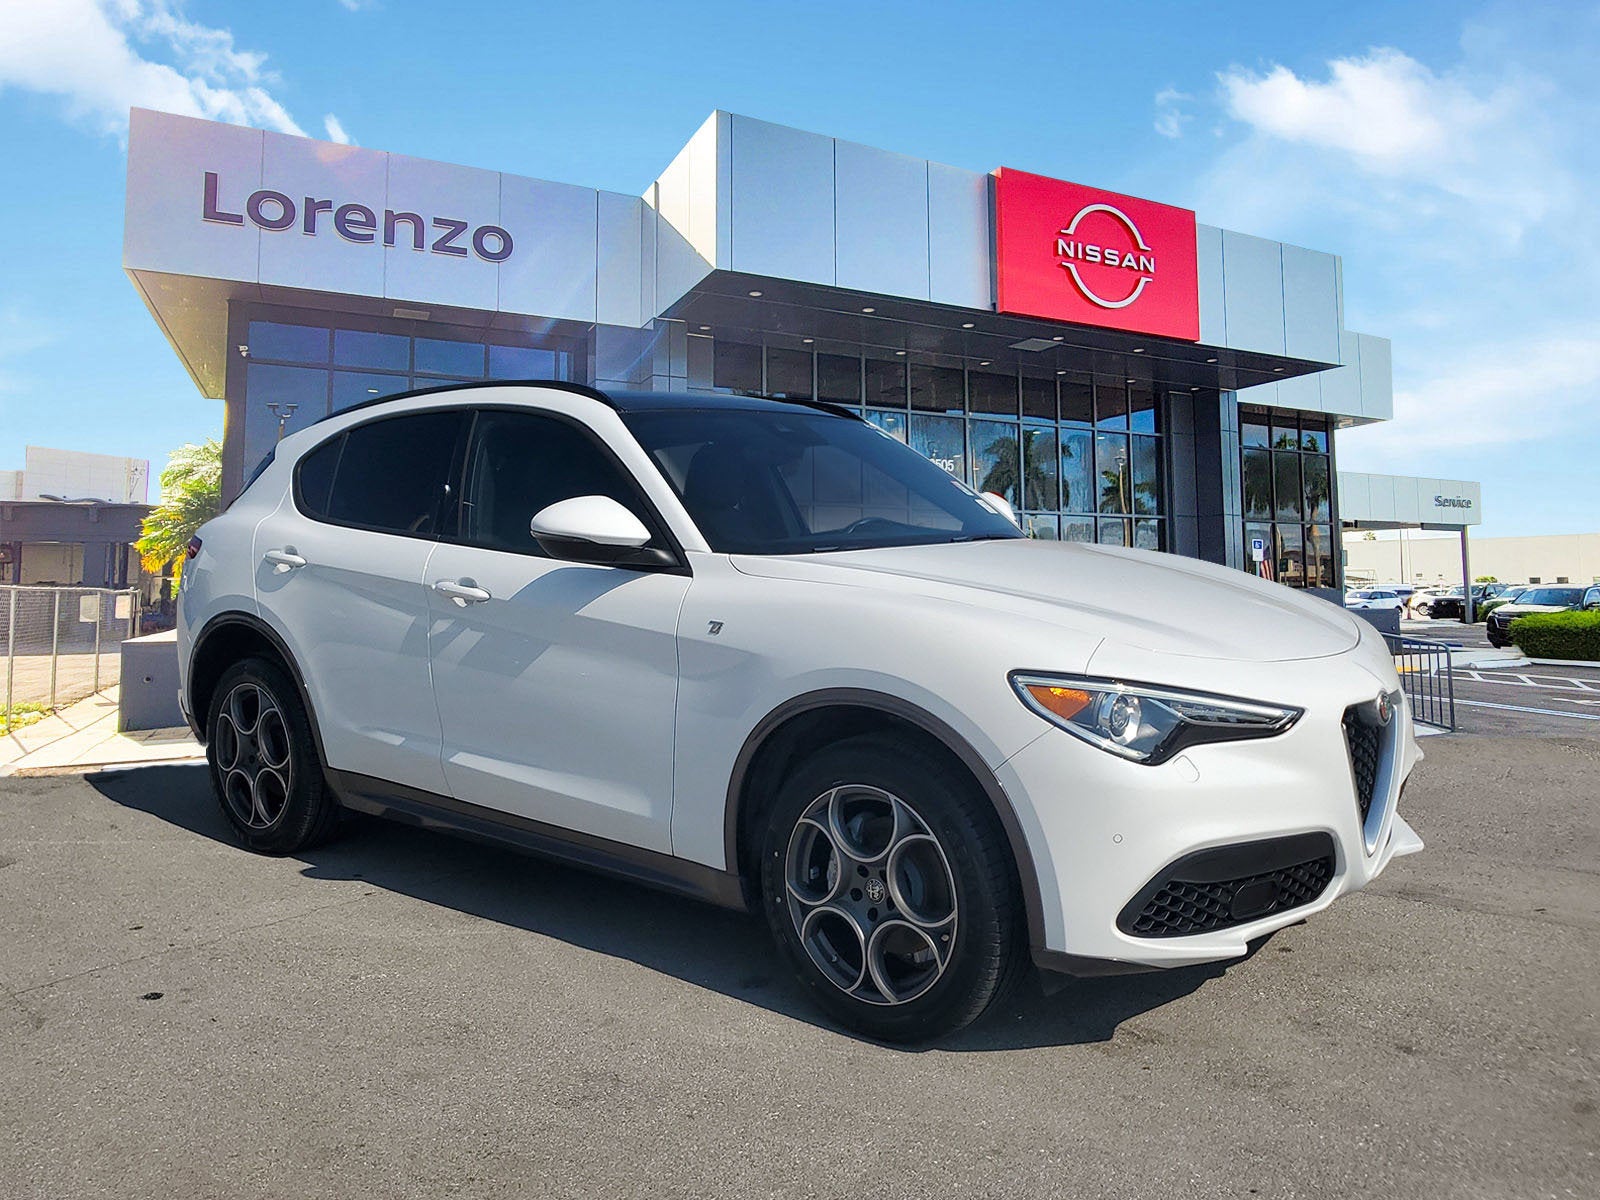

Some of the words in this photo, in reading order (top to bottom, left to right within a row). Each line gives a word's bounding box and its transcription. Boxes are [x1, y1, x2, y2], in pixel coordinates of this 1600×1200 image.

[202, 171, 514, 262] Lorenzo
[1057, 238, 1155, 273] NISSAN
[1434, 495, 1472, 508] Service
